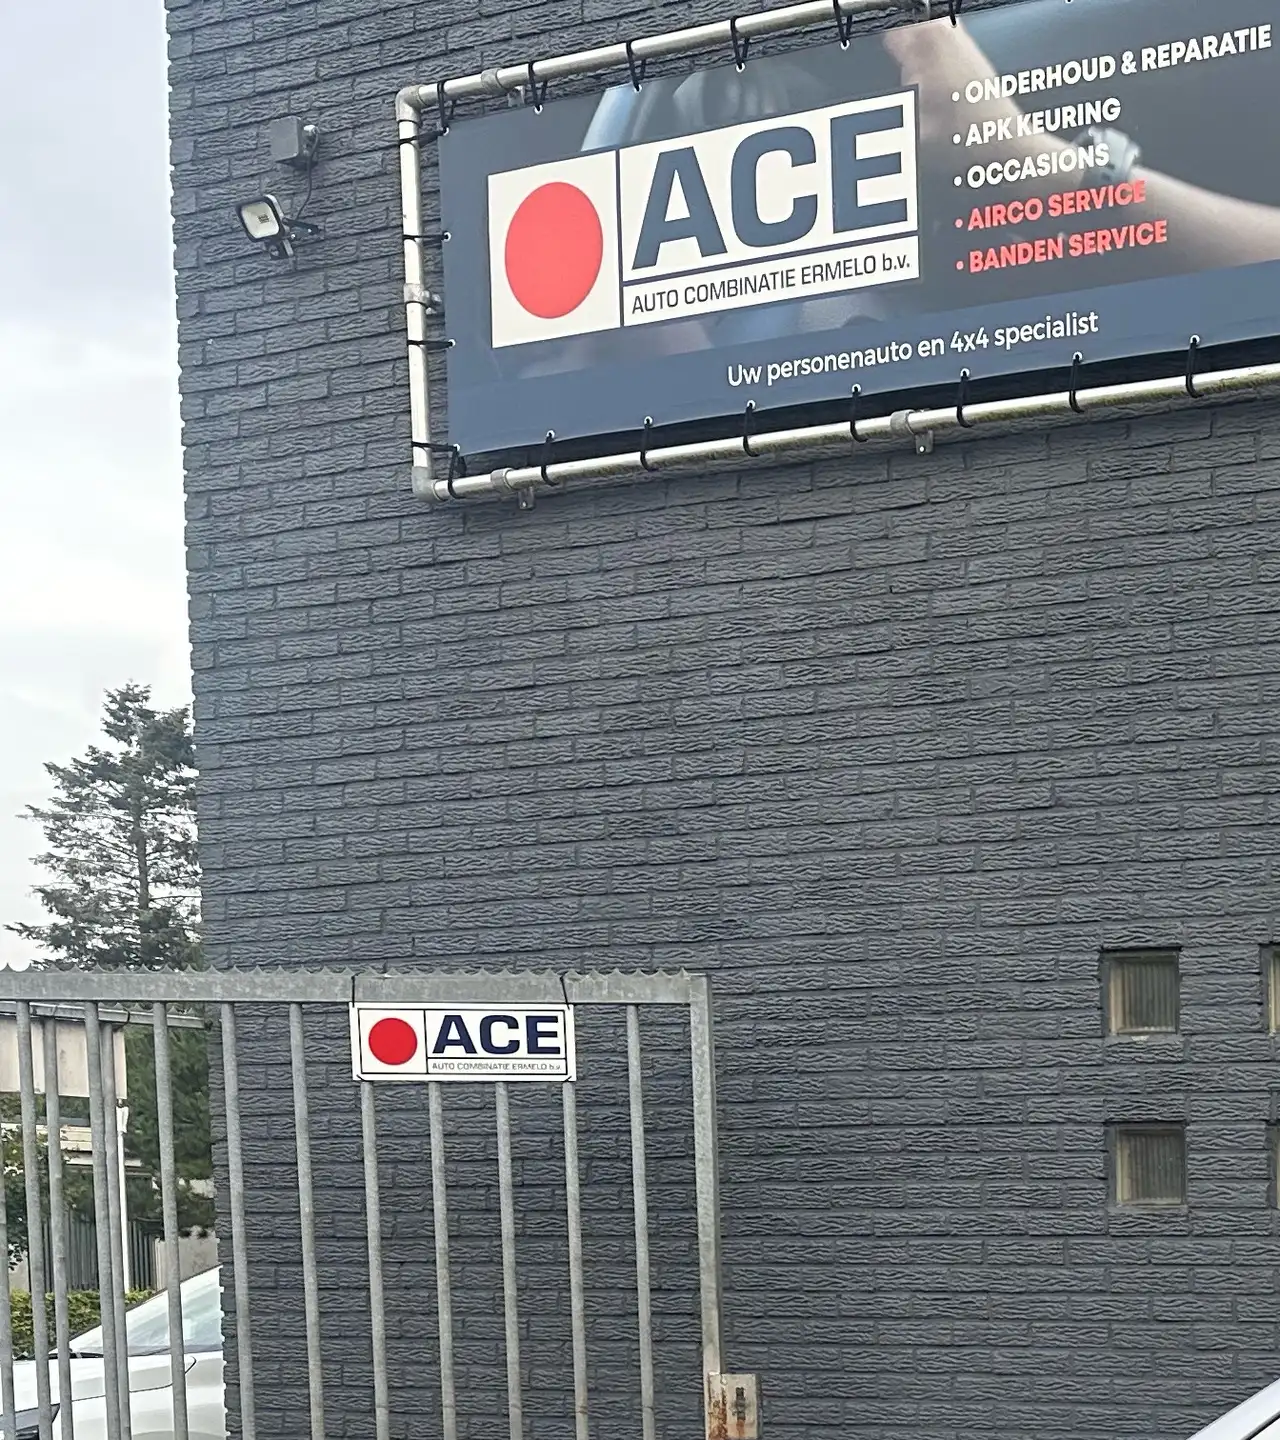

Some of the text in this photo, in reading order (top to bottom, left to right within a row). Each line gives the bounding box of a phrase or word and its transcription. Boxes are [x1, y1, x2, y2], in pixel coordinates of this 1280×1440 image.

[965, 24, 1272, 104] ONDERHOUD & REPARATIE
[965, 97, 1121, 147] APK KEURING
[632, 105, 908, 271] ACE
[967, 143, 1109, 188] OCCASIONS
[967, 180, 1146, 231] AIRCO SERVICE
[969, 220, 1167, 273] BANDEN SERVICE
[632, 253, 911, 314] AUTO COMBINATIE ERMELO b.v.
[727, 311, 1099, 387] Uw personenauto en 4x4 specialist
[432, 1014, 561, 1055] ACE
[432, 1062, 455, 1070] AUTO
